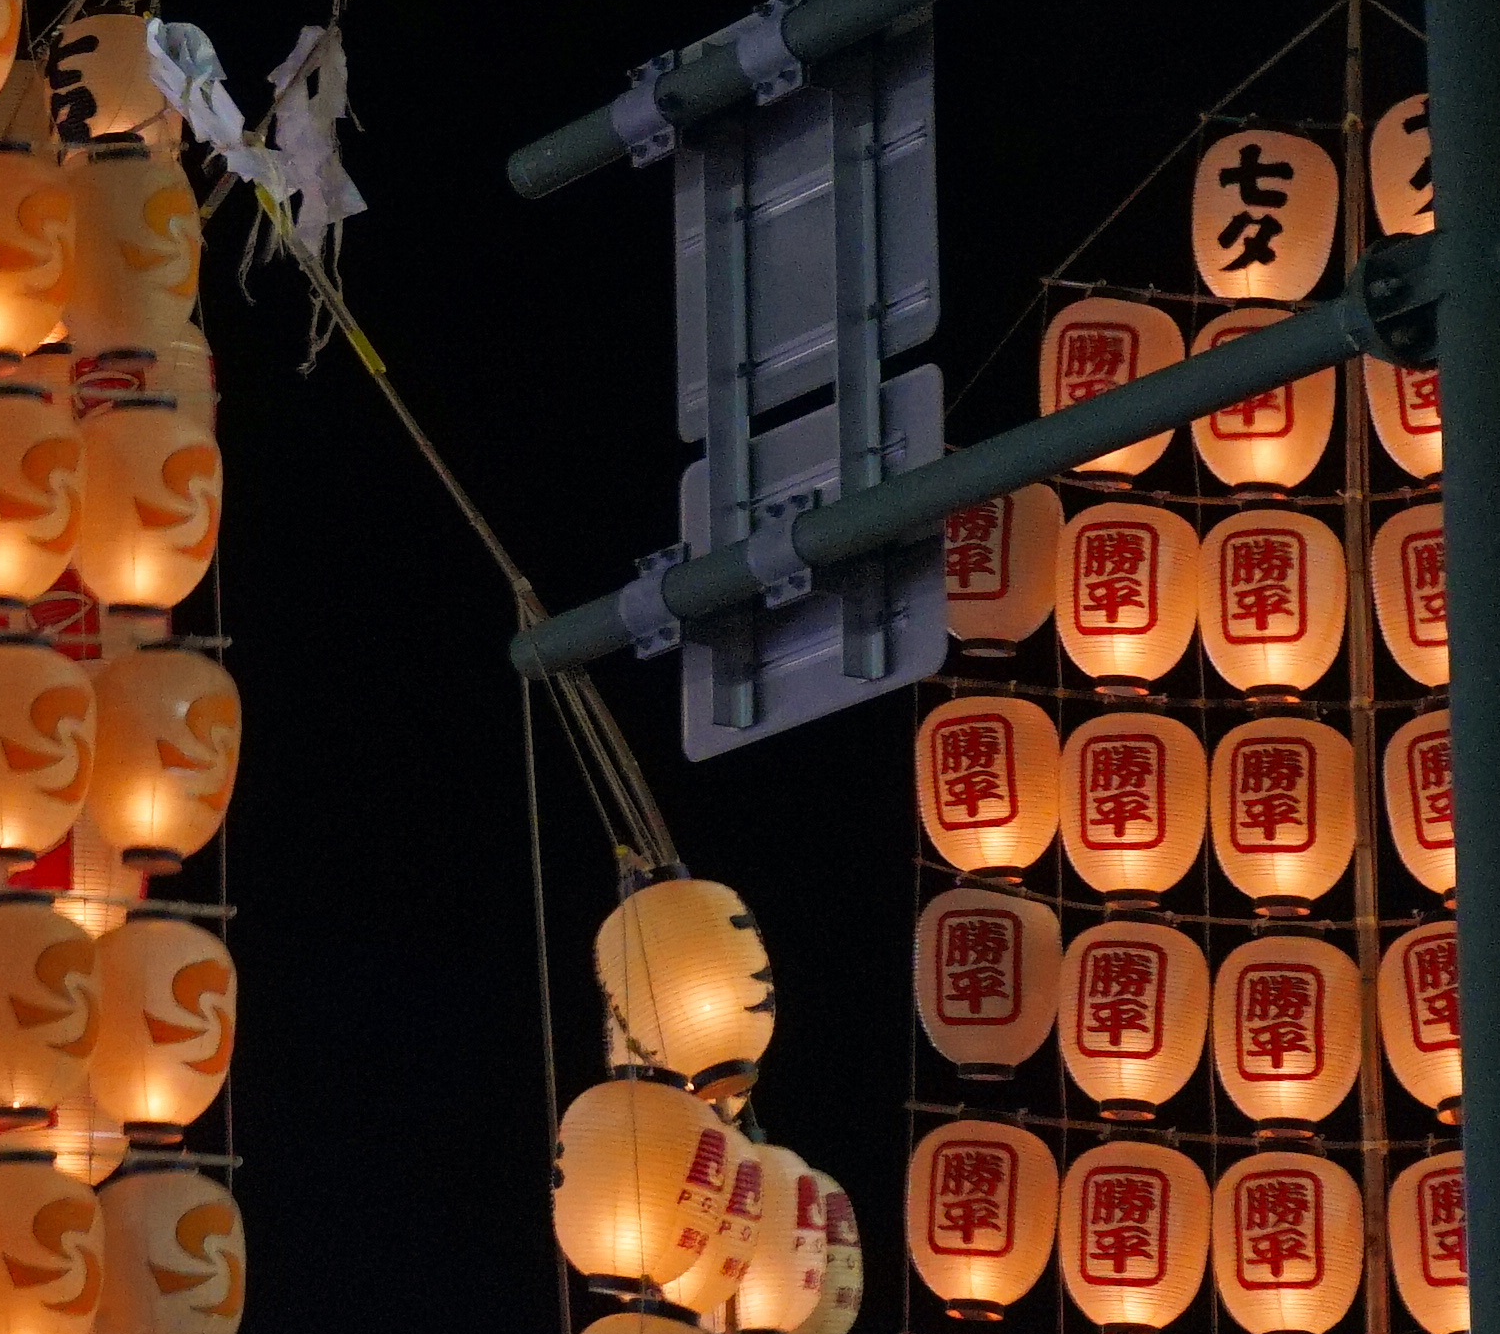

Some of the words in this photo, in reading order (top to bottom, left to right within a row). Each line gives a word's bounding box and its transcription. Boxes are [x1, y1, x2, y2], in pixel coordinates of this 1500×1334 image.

[1218, 144, 1294, 271] 七夕
[1084, 531, 1145, 623] 勝平
[1232, 539, 1293, 630] 勝平
[941, 727, 1004, 817] 勝平
[1089, 746, 1153, 837] 勝平
[1240, 748, 1304, 840] 勝平
[946, 920, 1010, 1013] 勝平
[1088, 953, 1153, 1046] 勝平
[1246, 975, 1312, 1069] 勝平
[938, 1154, 1004, 1244] 勝平
[1090, 1180, 1155, 1274] 勝平
[1245, 1182, 1311, 1277] 勝平
